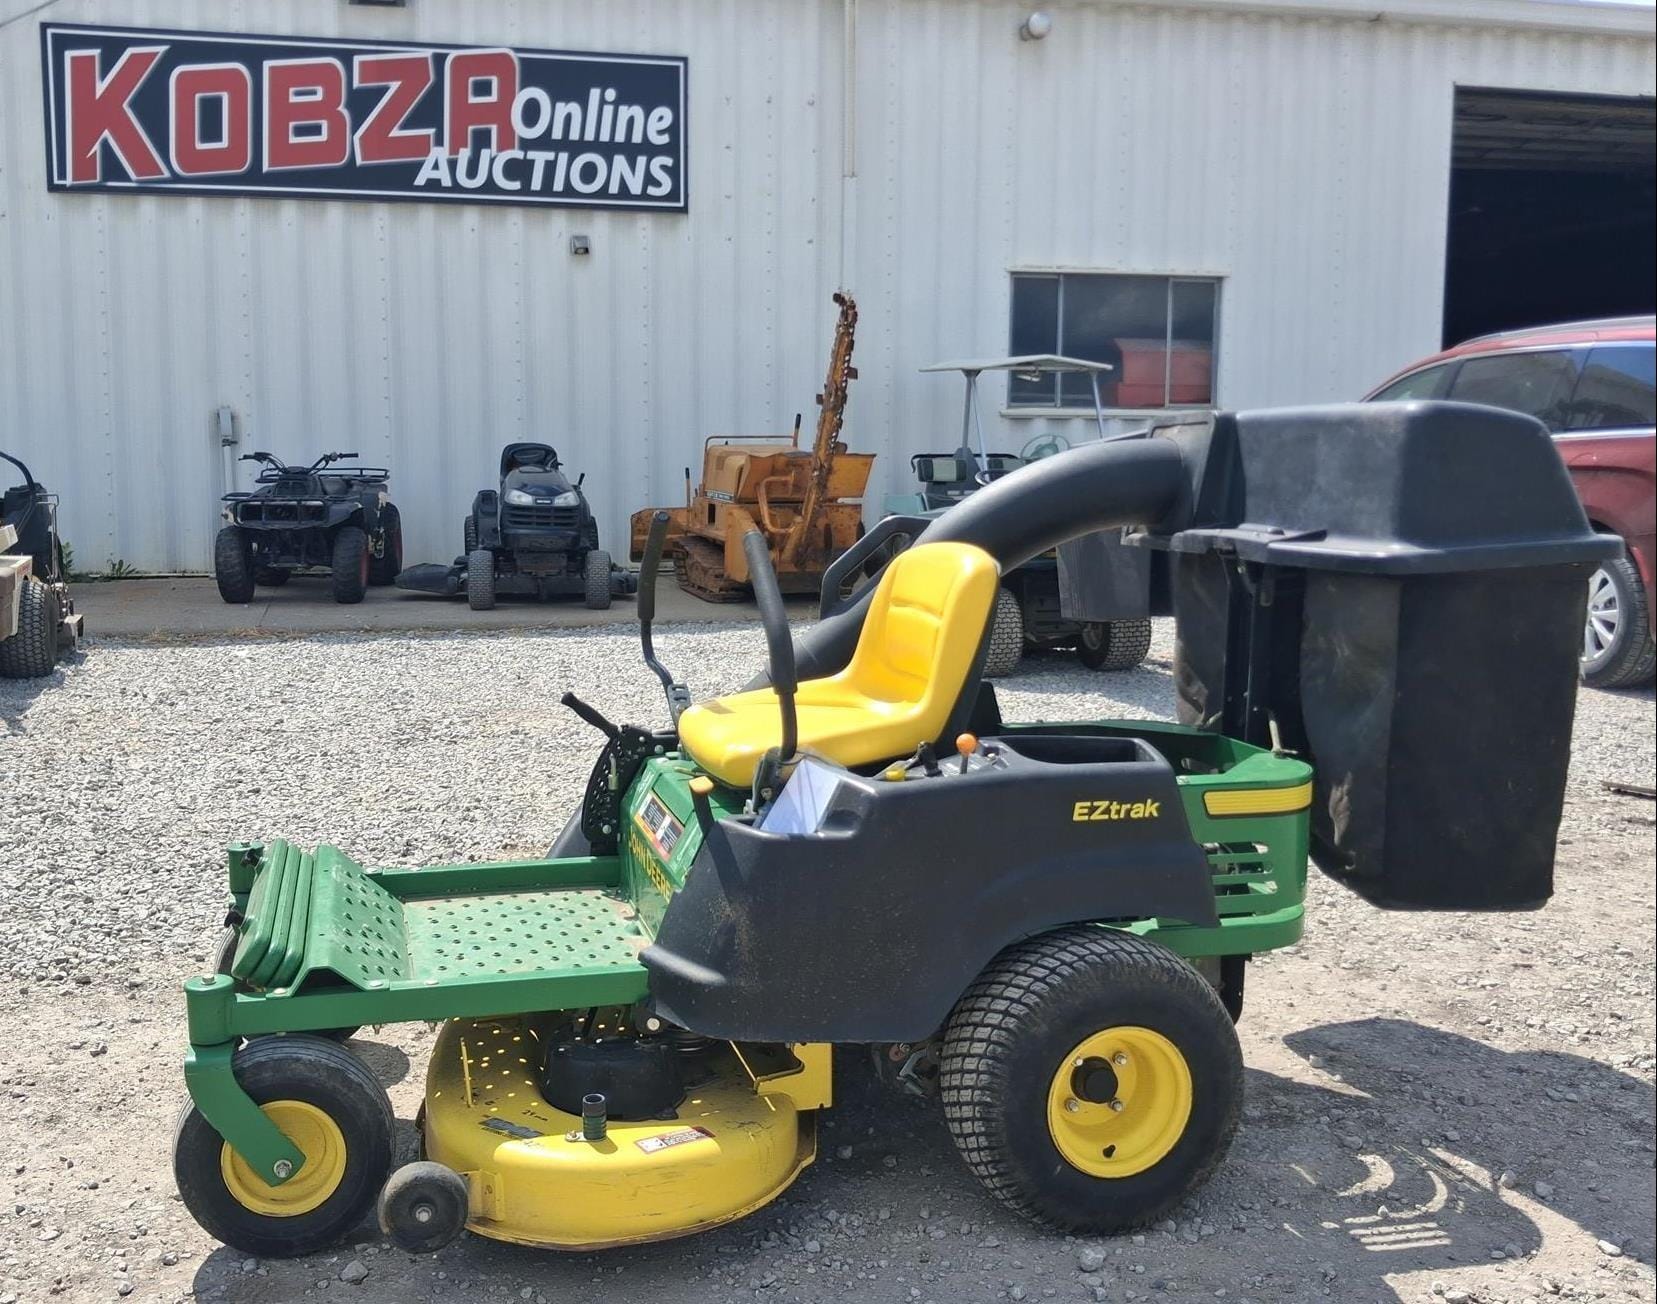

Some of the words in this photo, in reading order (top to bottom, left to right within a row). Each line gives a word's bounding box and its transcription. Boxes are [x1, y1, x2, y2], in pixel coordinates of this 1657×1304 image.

[64, 45, 519, 187] KOBZA
[511, 86, 674, 145] Online
[413, 146, 675, 197] AUCTIONS
[1072, 798, 1160, 821] EZtrak
